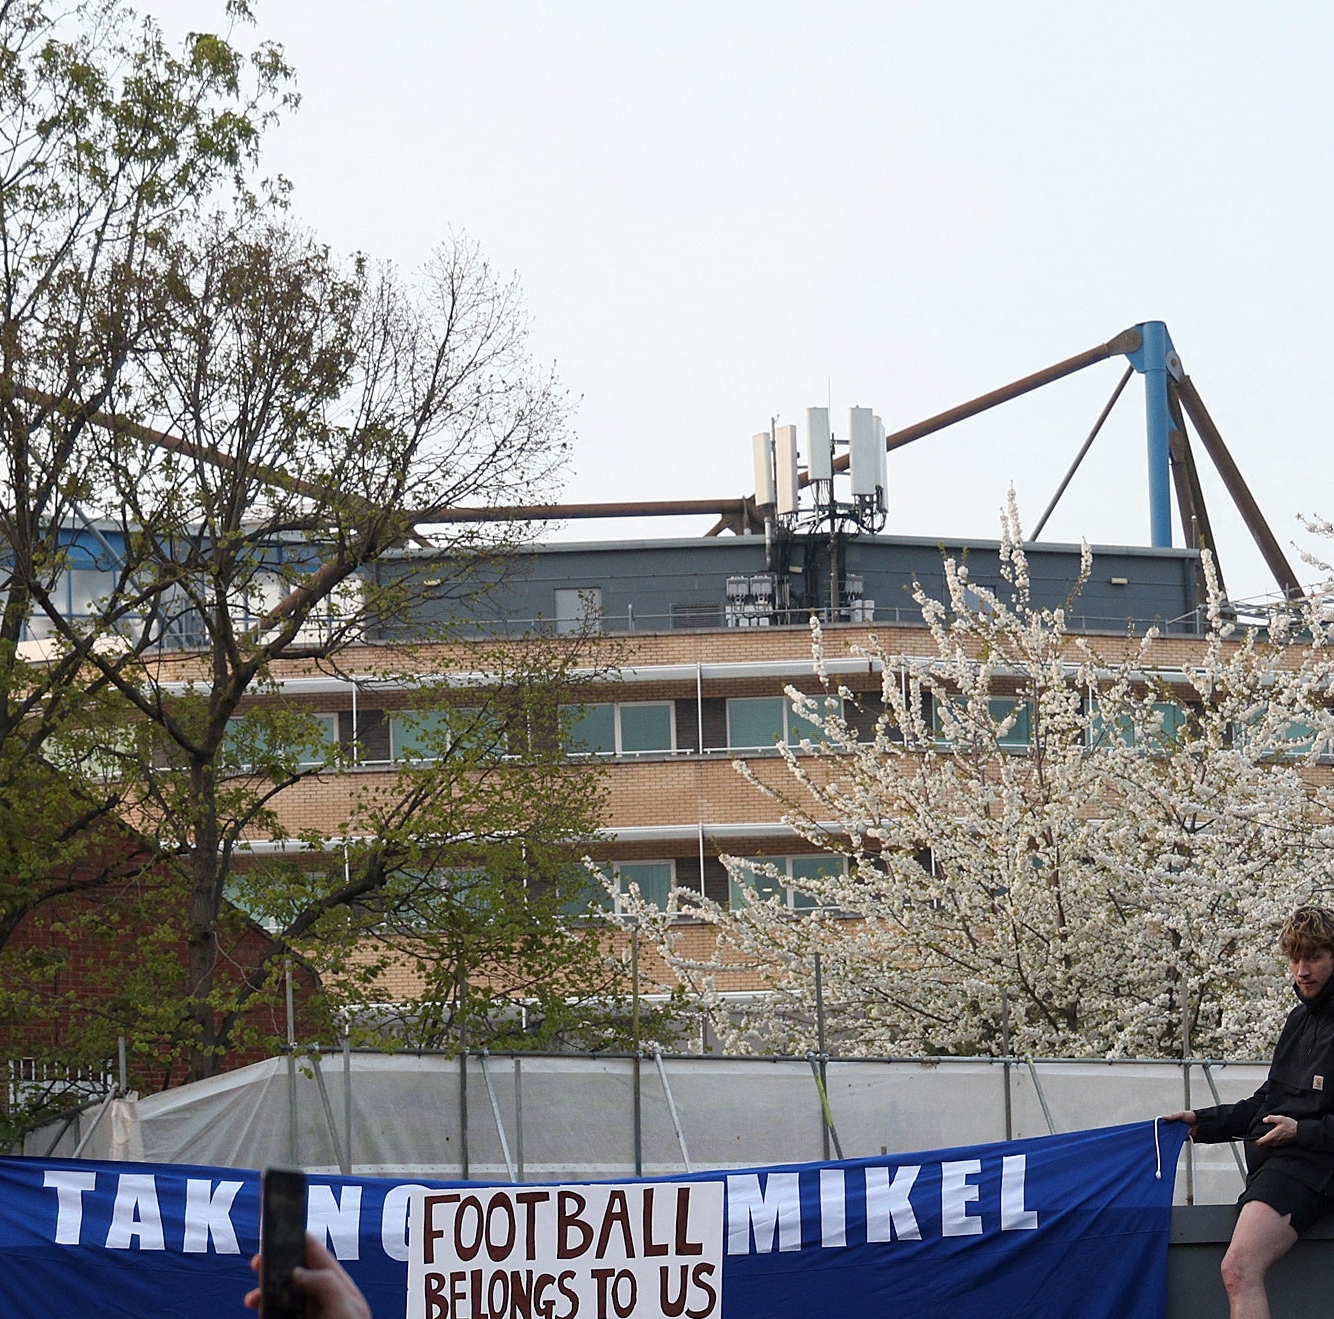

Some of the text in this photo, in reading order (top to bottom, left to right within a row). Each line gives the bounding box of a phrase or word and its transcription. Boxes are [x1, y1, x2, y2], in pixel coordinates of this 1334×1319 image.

[423, 1187, 703, 1265] FOOTBALL
[726, 1153, 1039, 1256] MIKEL
[659, 1262, 717, 1319] US
